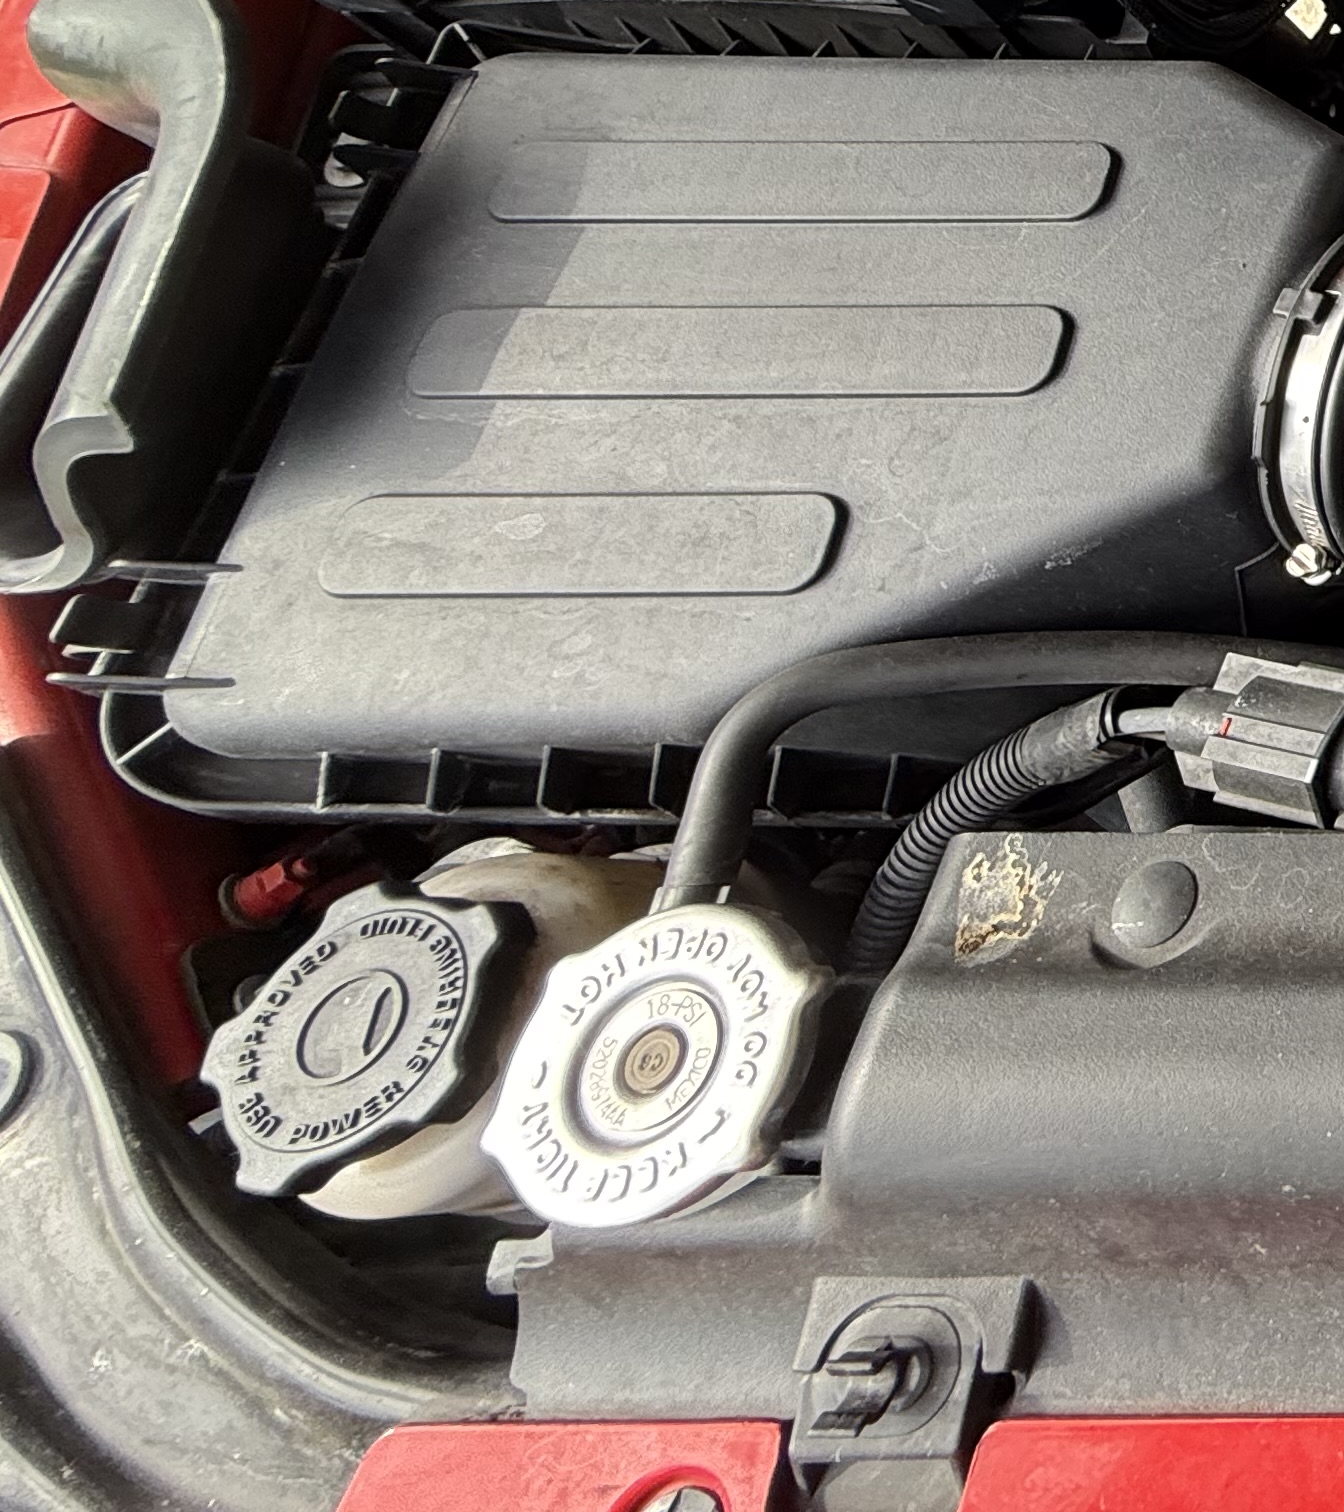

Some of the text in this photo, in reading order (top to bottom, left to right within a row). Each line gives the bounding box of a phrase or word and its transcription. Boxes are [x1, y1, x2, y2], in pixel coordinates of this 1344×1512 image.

[234, 939, 339, 1139] USE APPROVED
[288, 916, 463, 1145] POWER STEERING FLUID
[647, 994, 708, 1028] 18-PSI
[665, 1047, 712, 1111] MEXICO
